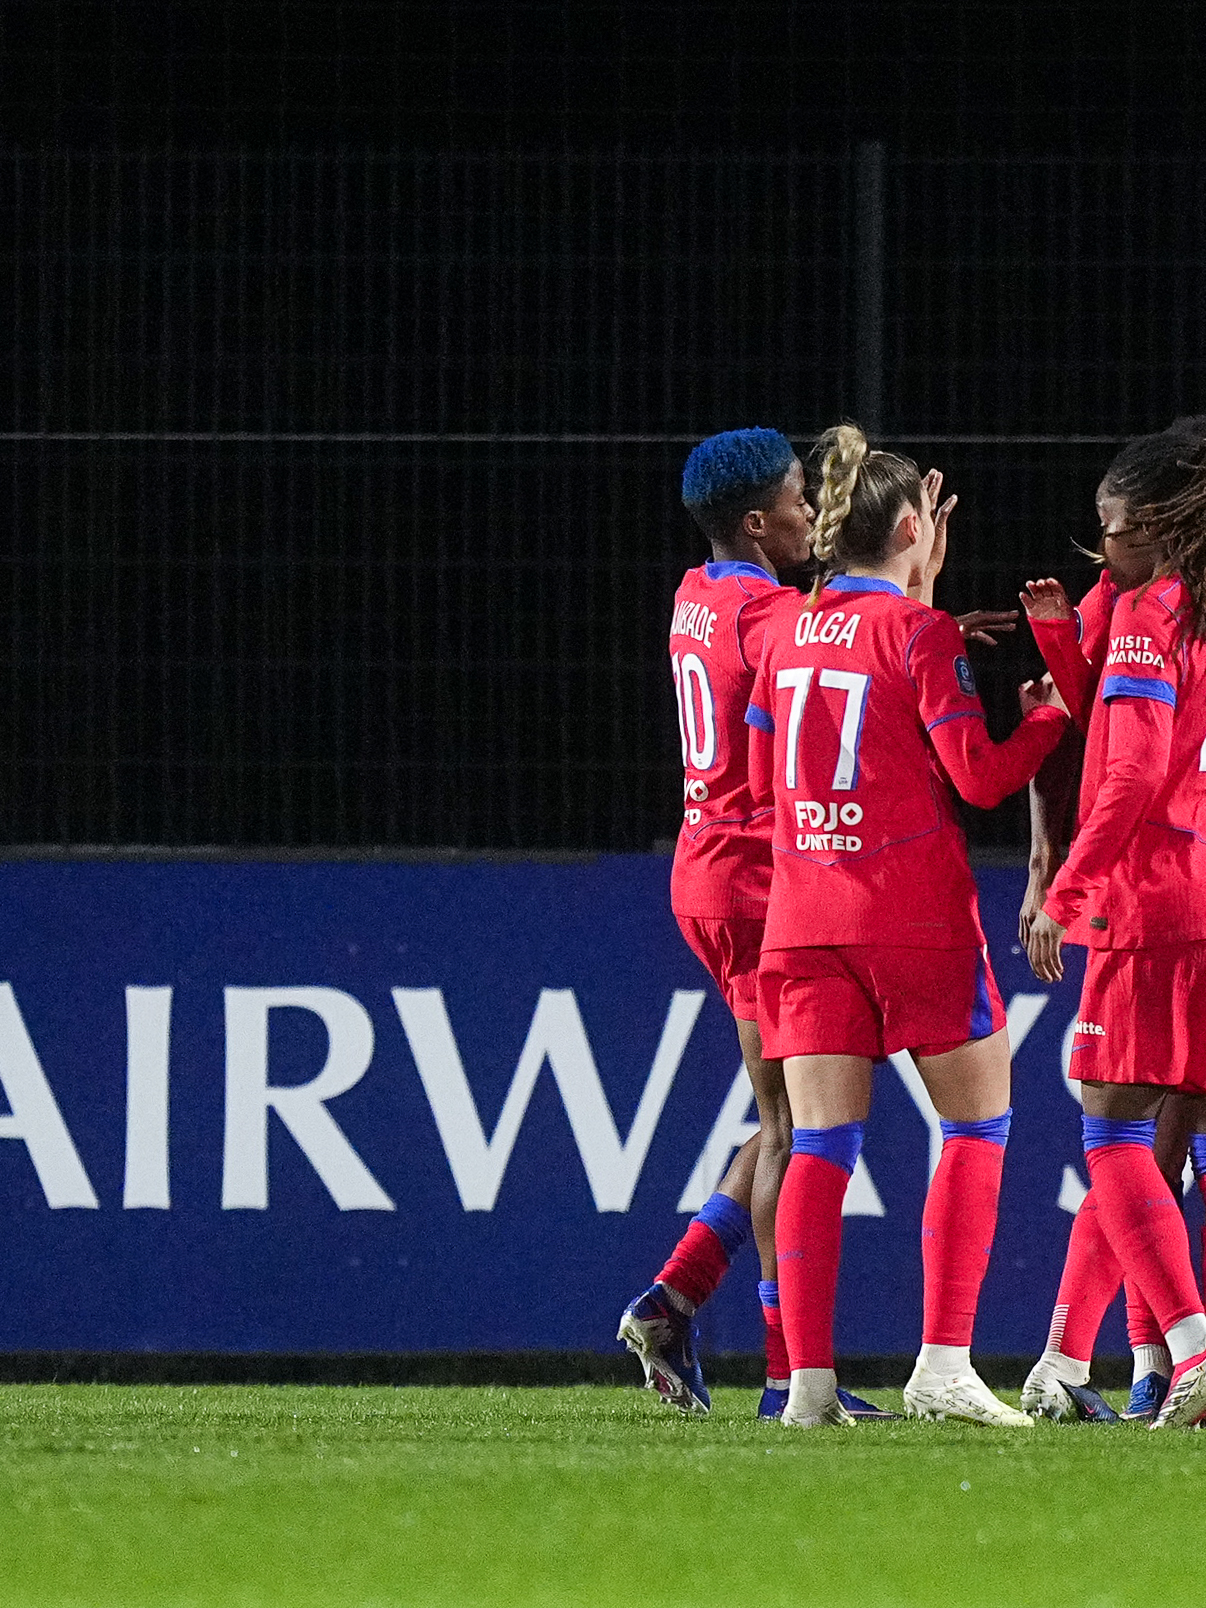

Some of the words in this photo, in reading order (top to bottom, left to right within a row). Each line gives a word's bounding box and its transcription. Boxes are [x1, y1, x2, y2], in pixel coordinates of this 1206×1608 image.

[795, 612, 861, 650] OLGA
[1111, 635, 1152, 651] VISIT
[1107, 650, 1165, 669] WANDA
[671, 653, 716, 771] 10
[776, 667, 871, 790] 77
[796, 833, 862, 852] UNTED
